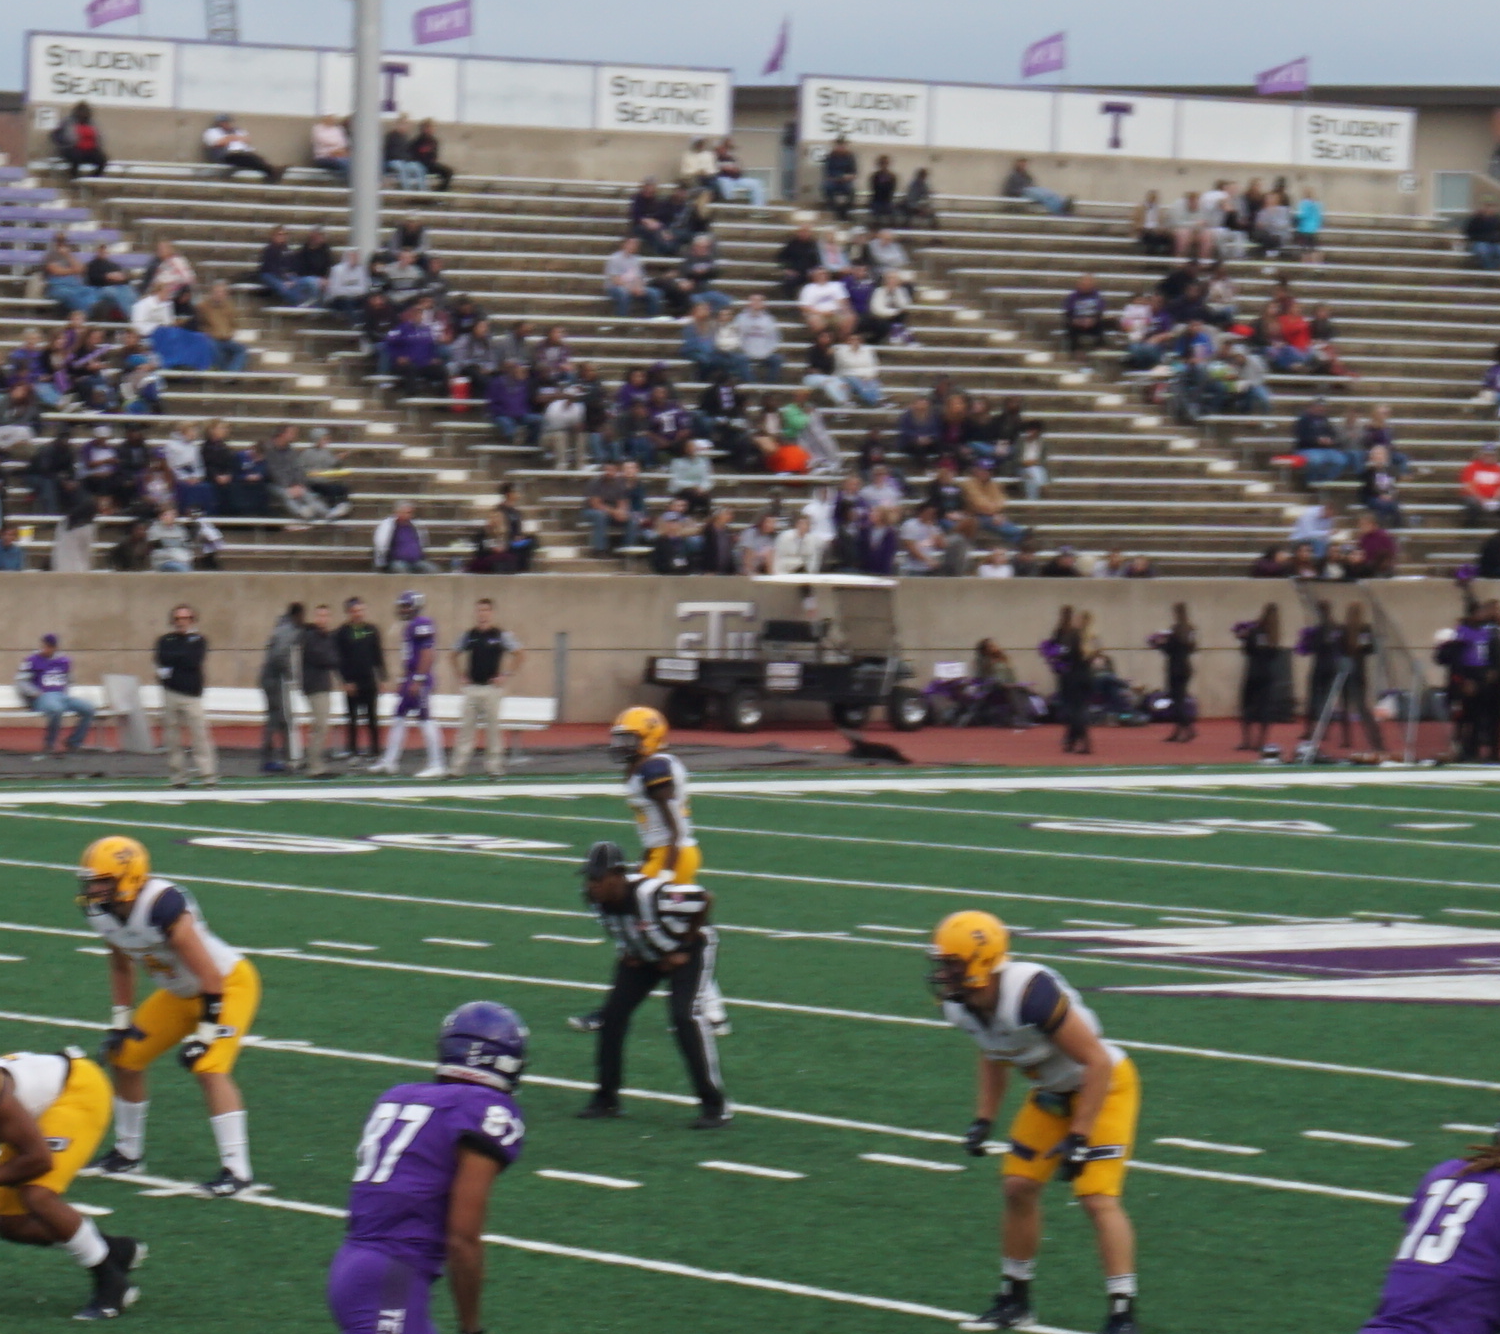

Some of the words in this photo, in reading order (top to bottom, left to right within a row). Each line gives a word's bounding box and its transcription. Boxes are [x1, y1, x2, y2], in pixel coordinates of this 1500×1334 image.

[44, 44, 162, 71] STUDENT
[51, 72, 154, 99] SEATING
[609, 74, 714, 101] STUDENT
[817, 86, 918, 112] STUDENT
[616, 102, 710, 127] SEATING
[821, 112, 912, 138] SEATING
[1307, 113, 1398, 138] STUDENT
[1311, 139, 1395, 163] SEATING
[351, 1101, 436, 1184] 87
[1395, 1178, 1489, 1265] 13
